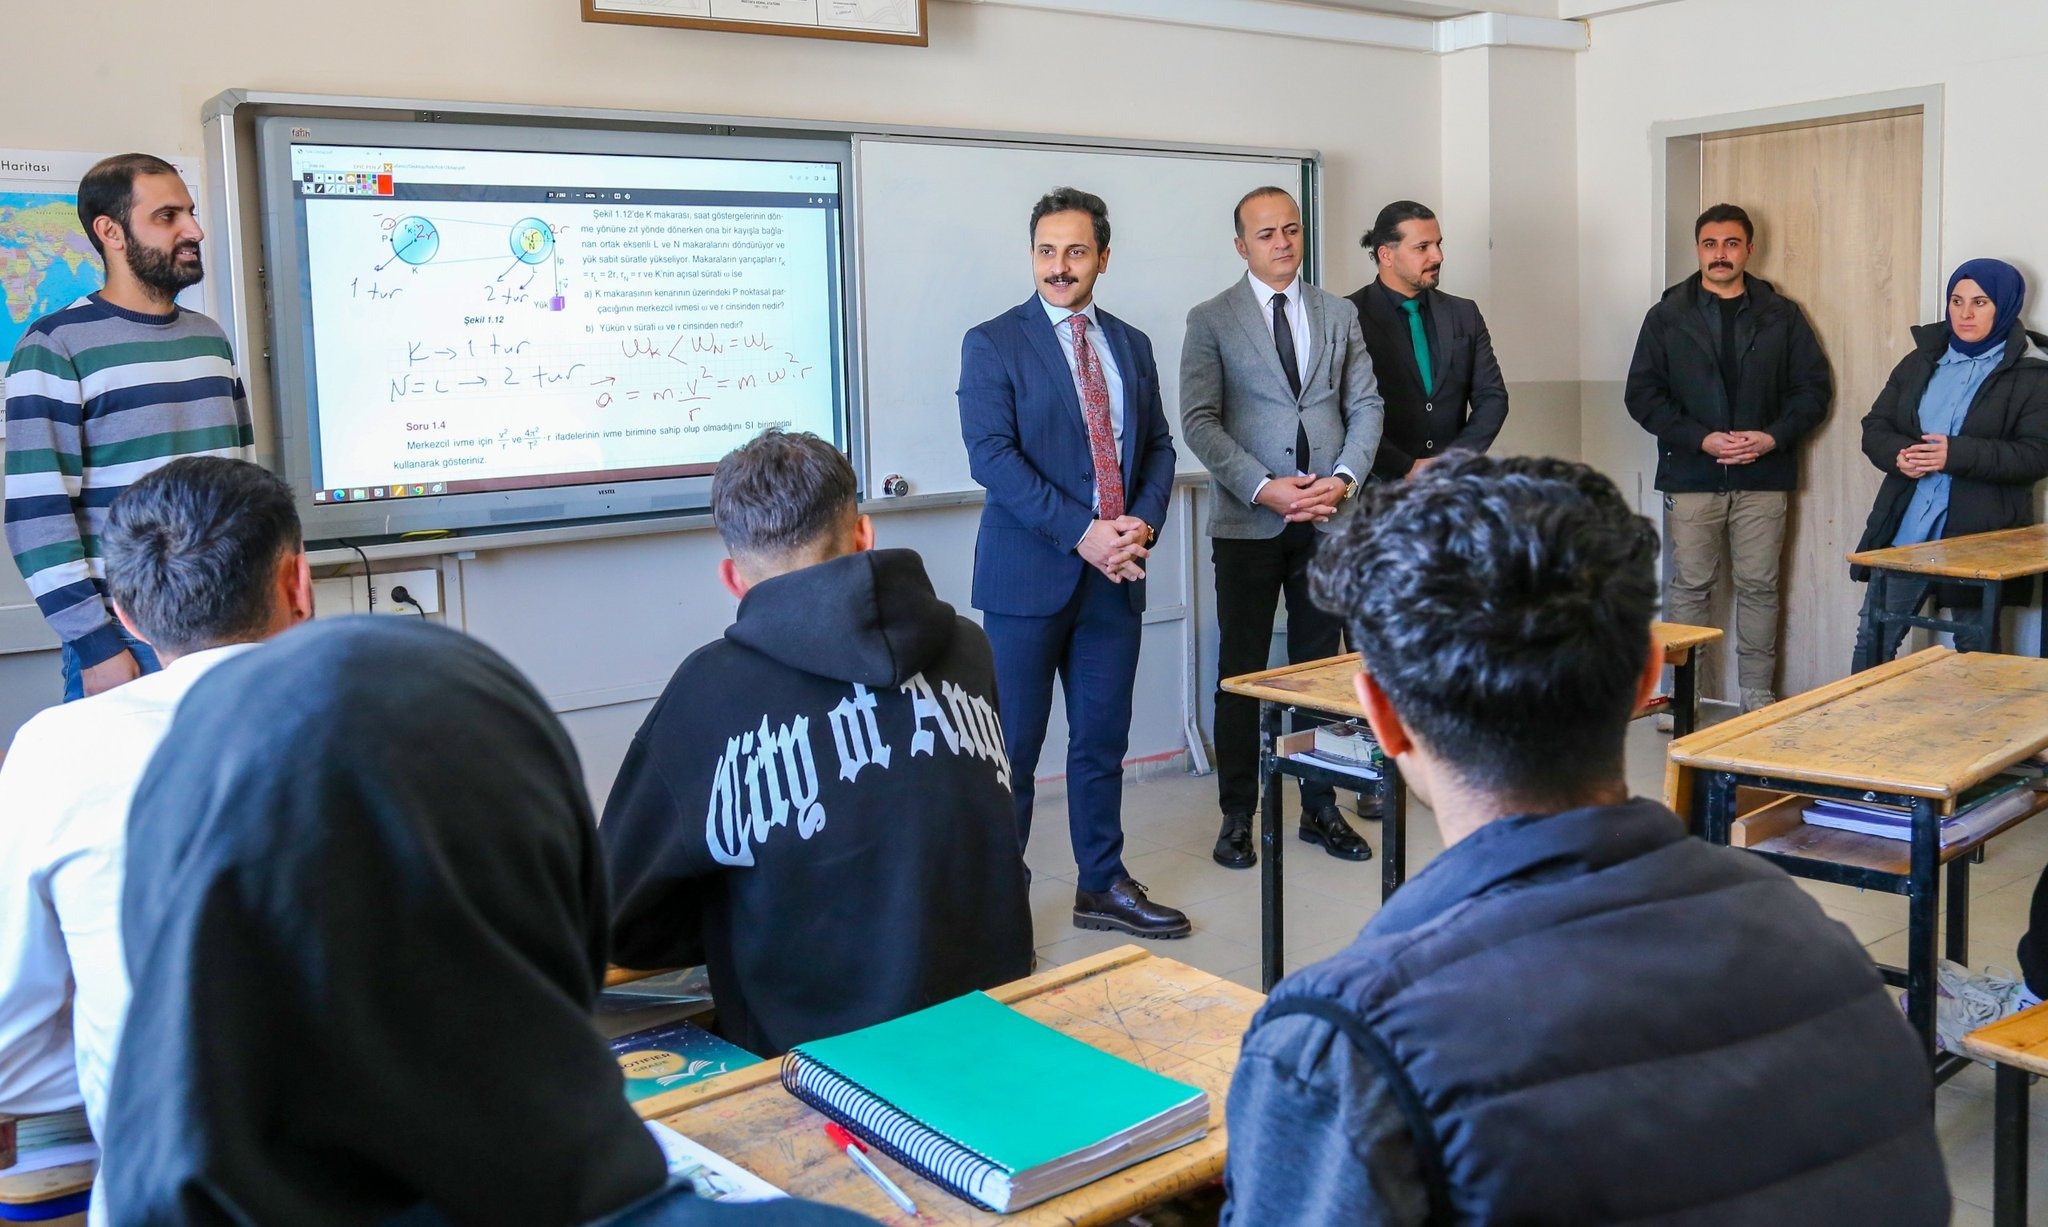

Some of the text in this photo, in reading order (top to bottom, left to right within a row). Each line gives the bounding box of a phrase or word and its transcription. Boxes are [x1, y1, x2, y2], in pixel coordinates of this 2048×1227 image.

[1, 160, 50, 172] Haritası
[593, 209, 613, 219] Şekil
[654, 211, 692, 220] makarası,
[712, 212, 766, 221] göstergelerinin
[597, 226, 626, 234] yönüne
[641, 226, 664, 234] yönde
[734, 226, 759, 236] kayışla
[732, 241, 773, 250] döndürüyor
[583, 255, 597, 264] yük
[599, 255, 618, 263] sabit
[621, 255, 647, 263] süratle
[650, 255, 689, 265] yükseliyor.
[693, 255, 736, 263] Makaraların
[739, 256, 777, 265] yarıçapları
[677, 270, 699, 279] açısal
[368, 282, 403, 300] tur
[484, 286, 495, 301] 2
[584, 290, 592, 299] a)
[604, 289, 652, 298] makarasının
[654, 289, 690, 297] kenarının
[740, 288, 770, 296] noktasal
[636, 303, 673, 312] merkezcil
[675, 303, 699, 311] ivmesi
[726, 302, 760, 311] cinsinden
[762, 301, 785, 310] nedir?
[464, 316, 504, 326] Şekil 1.12
[586, 324, 594, 333] b)
[600, 324, 625, 332] Yükün
[682, 322, 718, 330] cinsinden
[721, 320, 743, 329] nedir?
[504, 366, 520, 385] 2
[406, 421, 446, 431] Soru 1.4
[408, 440, 449, 450] Merkezcil
[453, 438, 474, 447] ivme
[478, 438, 493, 448] için
[555, 430, 599, 441] ifadelerinin
[626, 428, 656, 437] birimine
[660, 426, 680, 436] sahip
[684, 425, 700, 434] olup
[703, 422, 741, 433] olmadığını
[394, 457, 487, 470] kullanarak gösteriniz.
[706, 714, 826, 867] City
[827, 682, 892, 783] of
[620, 1052, 670, 1070] OTIFIER
